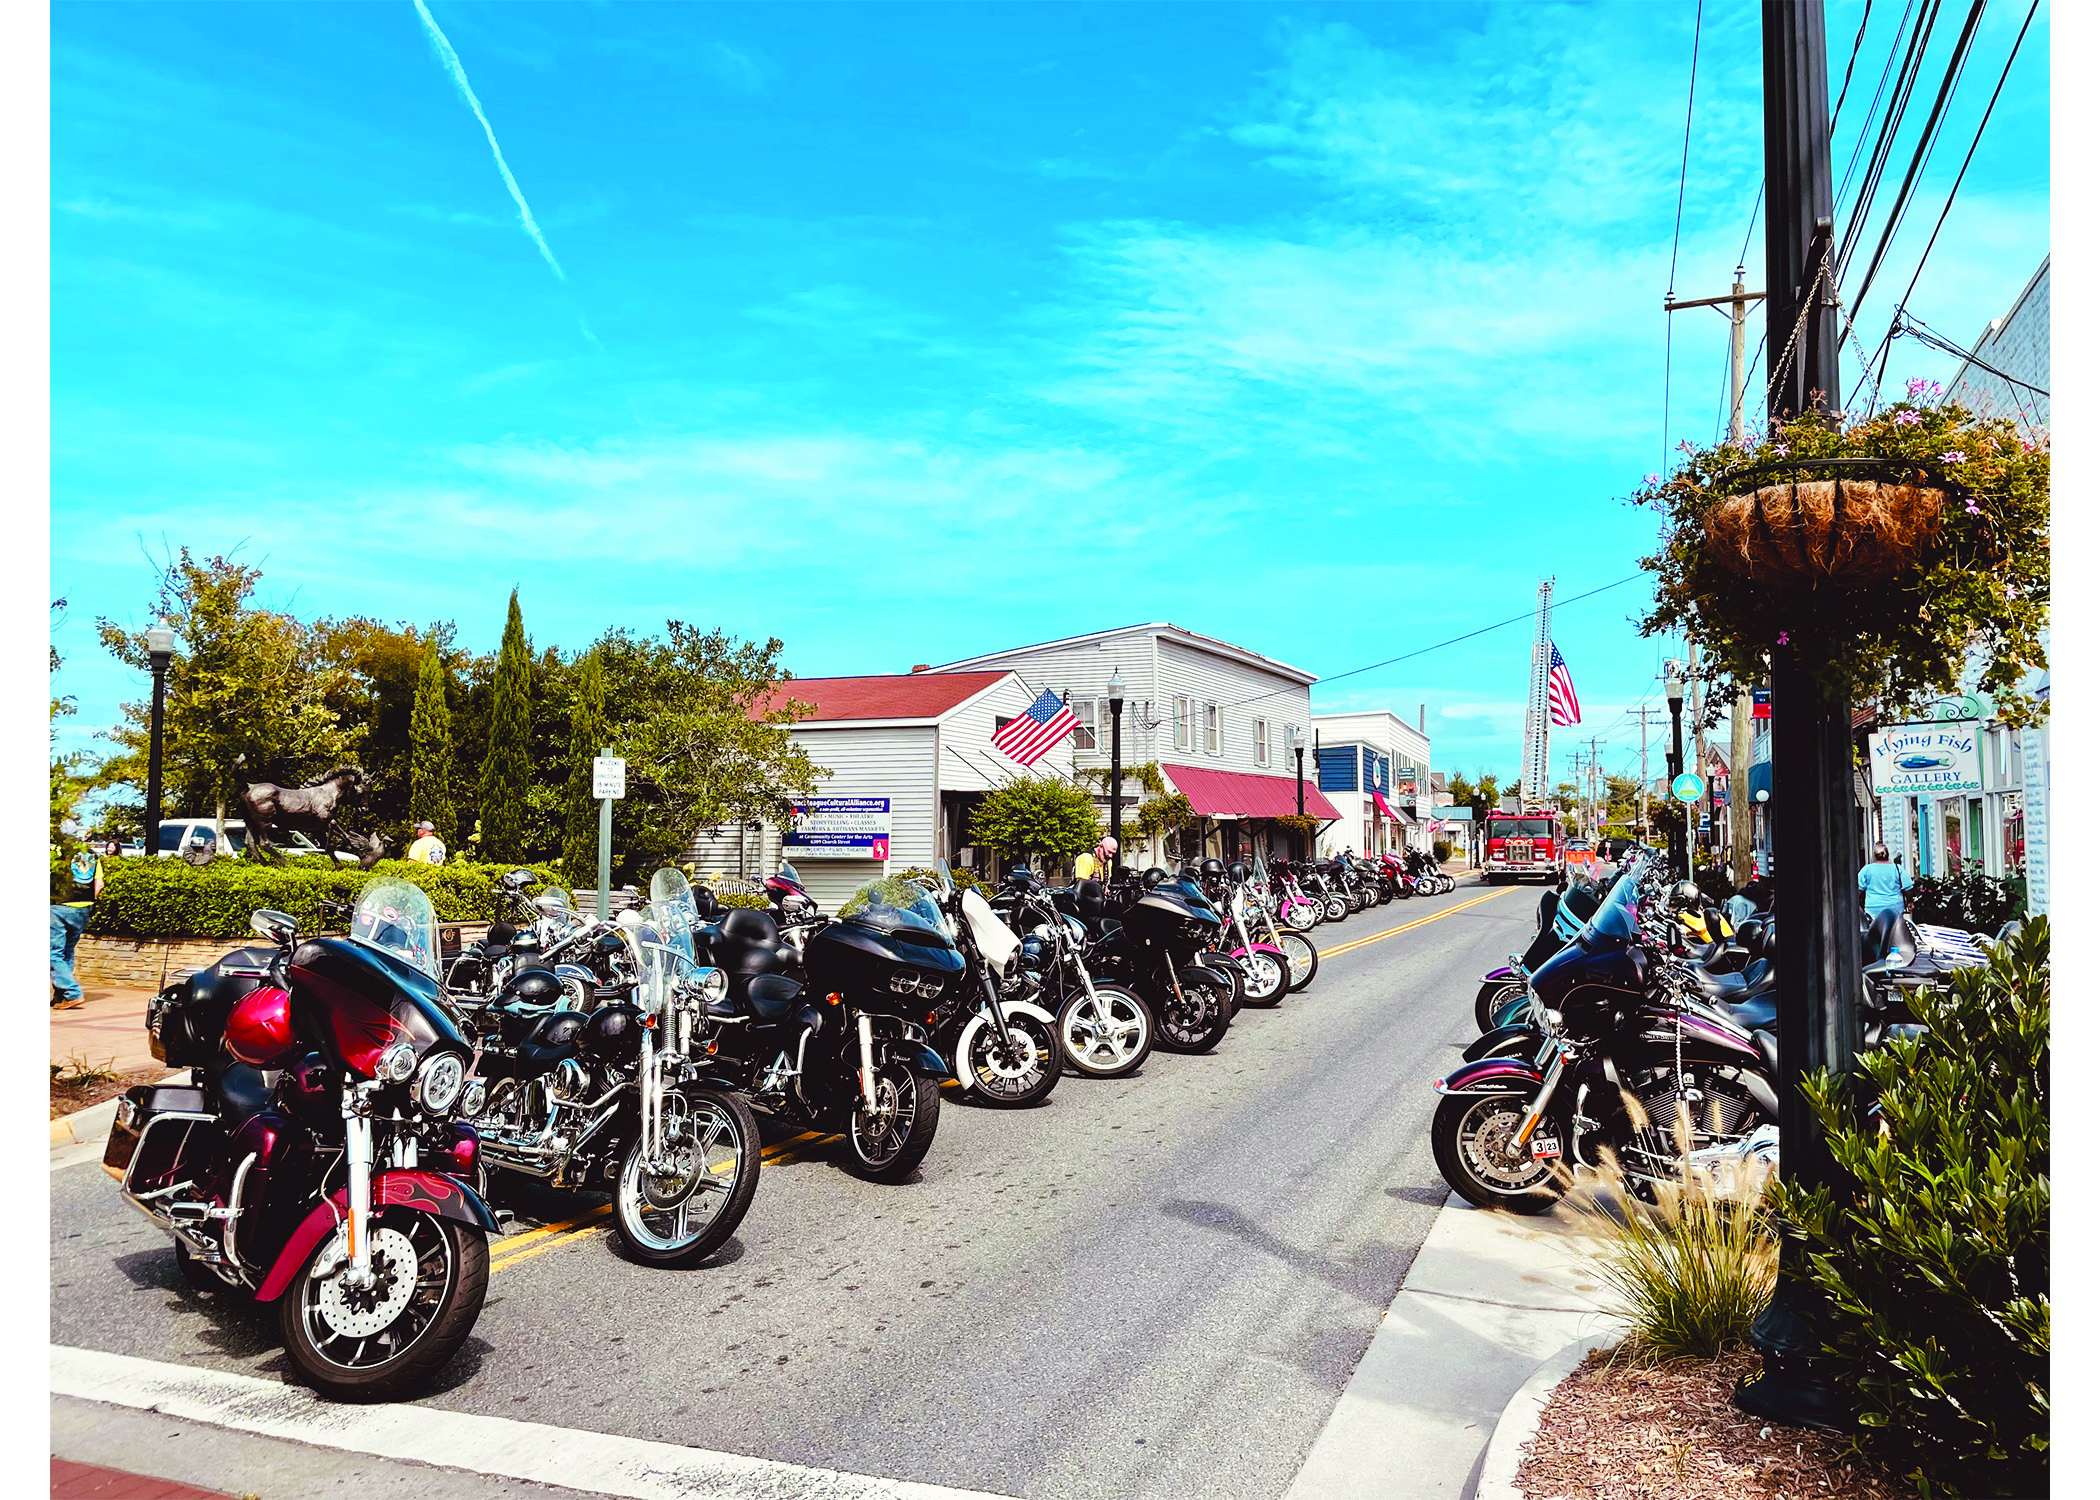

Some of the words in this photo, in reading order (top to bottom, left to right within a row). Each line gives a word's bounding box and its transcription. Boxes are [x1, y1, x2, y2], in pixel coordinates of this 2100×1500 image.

[1876, 733, 1931, 758] Flying
[1937, 734, 1973, 754] Fish
[1890, 771, 1962, 785] GALLERY
[1639, 1033, 1688, 1041] HARLEY-DAVIDON
[1536, 1142, 1544, 1152] 3
[1546, 1142, 1557, 1151] 23
